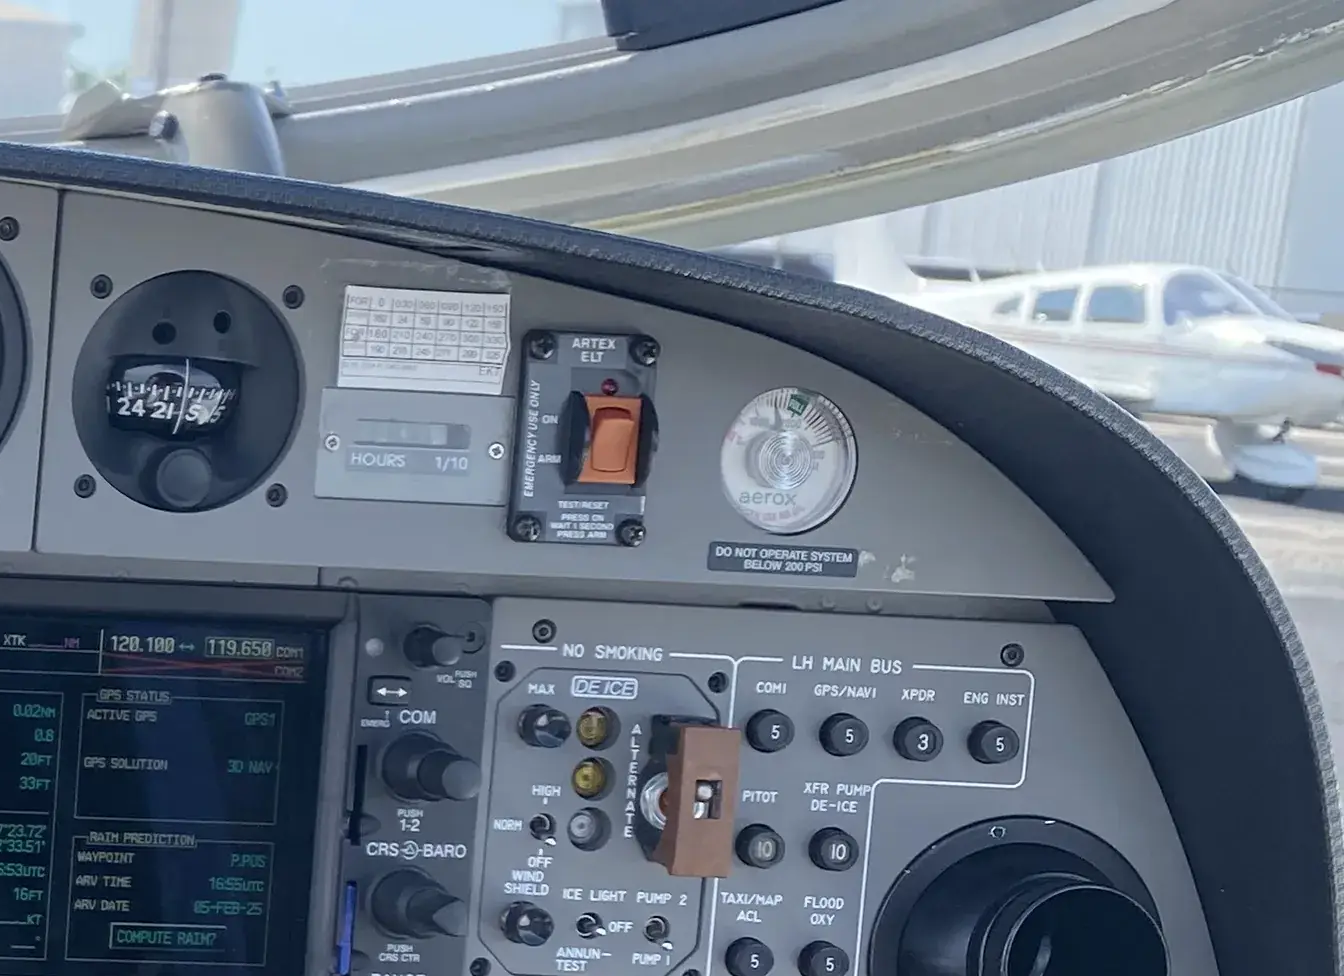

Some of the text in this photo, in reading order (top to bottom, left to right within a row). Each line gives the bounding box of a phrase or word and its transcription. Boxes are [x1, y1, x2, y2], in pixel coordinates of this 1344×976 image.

[571, 337, 616, 350] ARTEX
[580, 350, 605, 363] ELT
[350, 451, 406, 468] HOURS
[435, 456, 469, 472] 1/10
[715, 546, 853, 563] DO NOT OPERATE SYSTEM
[743, 558, 823, 573] BELOW 200 PSI
[562, 643, 664, 662] NO SMOKING
[791, 655, 902, 675] LH MAIN BUS
[901, 688, 936, 702] XPDR
[963, 691, 1026, 706] ENG INST
[742, 789, 779, 804] PITOT
